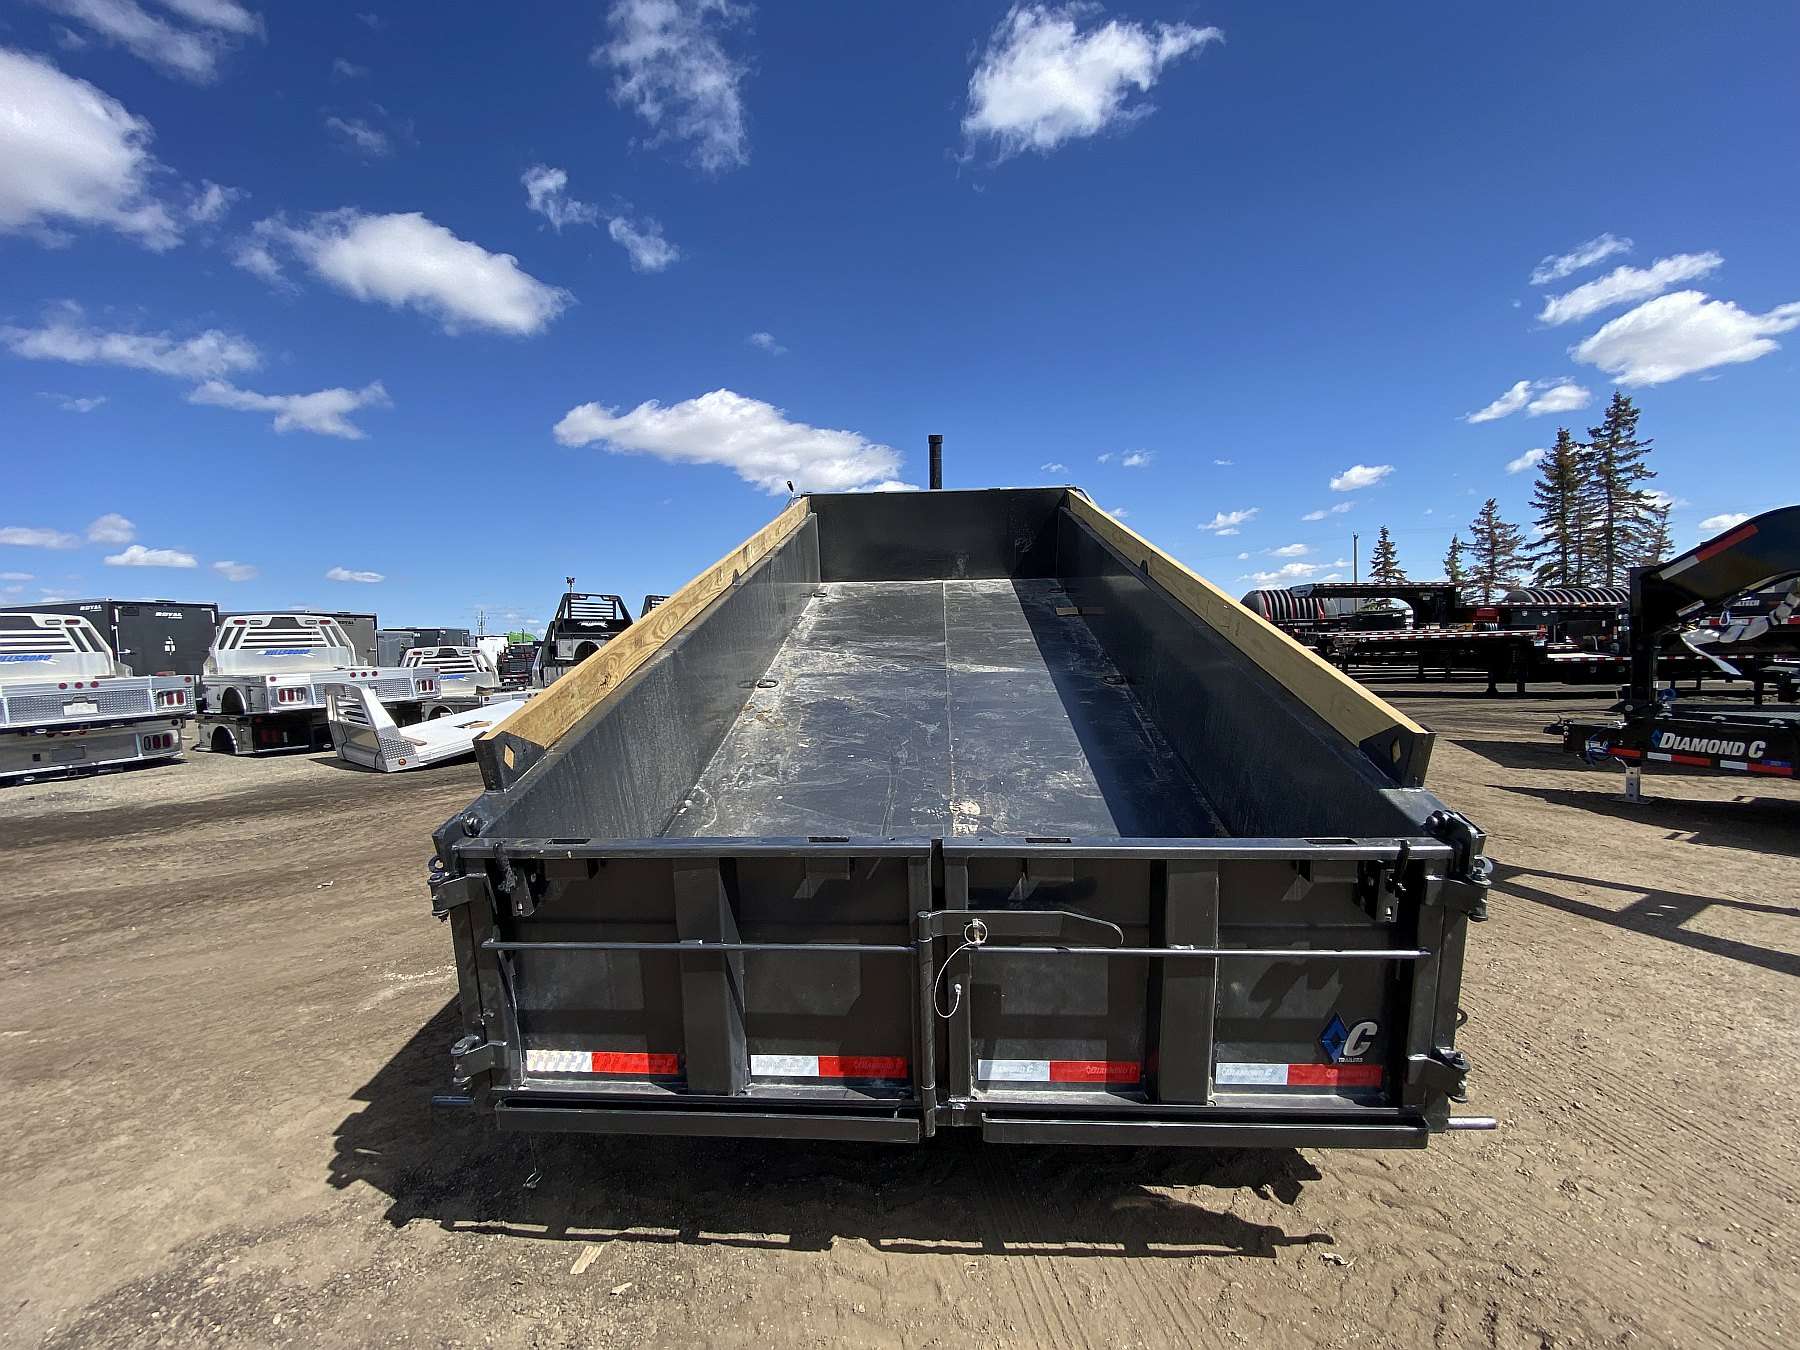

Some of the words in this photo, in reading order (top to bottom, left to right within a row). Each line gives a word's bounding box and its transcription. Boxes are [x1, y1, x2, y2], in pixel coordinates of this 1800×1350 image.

[1659, 732, 1745, 756] DIAMOND
[1748, 741, 1766, 759] C
[1343, 1021, 1378, 1057] C
